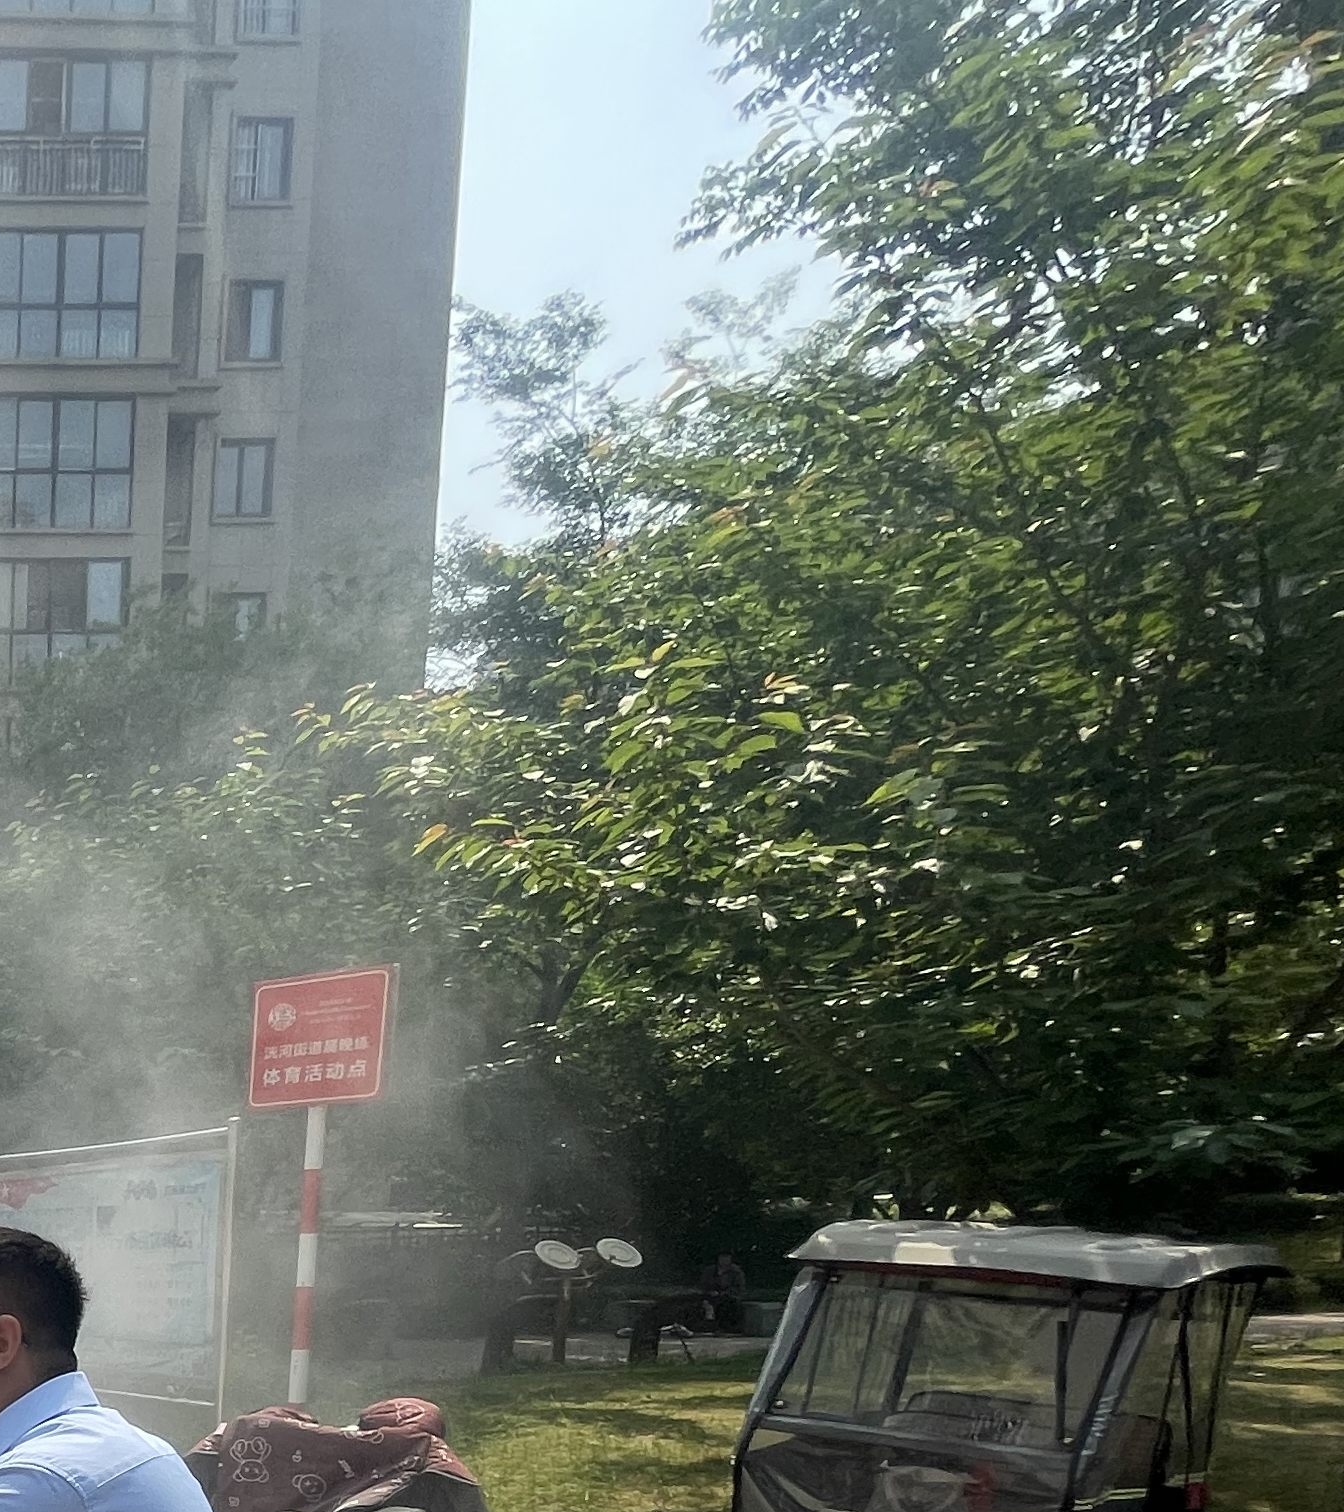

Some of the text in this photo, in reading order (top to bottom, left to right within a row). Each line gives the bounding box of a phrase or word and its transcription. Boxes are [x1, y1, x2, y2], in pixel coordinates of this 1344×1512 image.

[262, 1059, 367, 1086] 体育活动点
